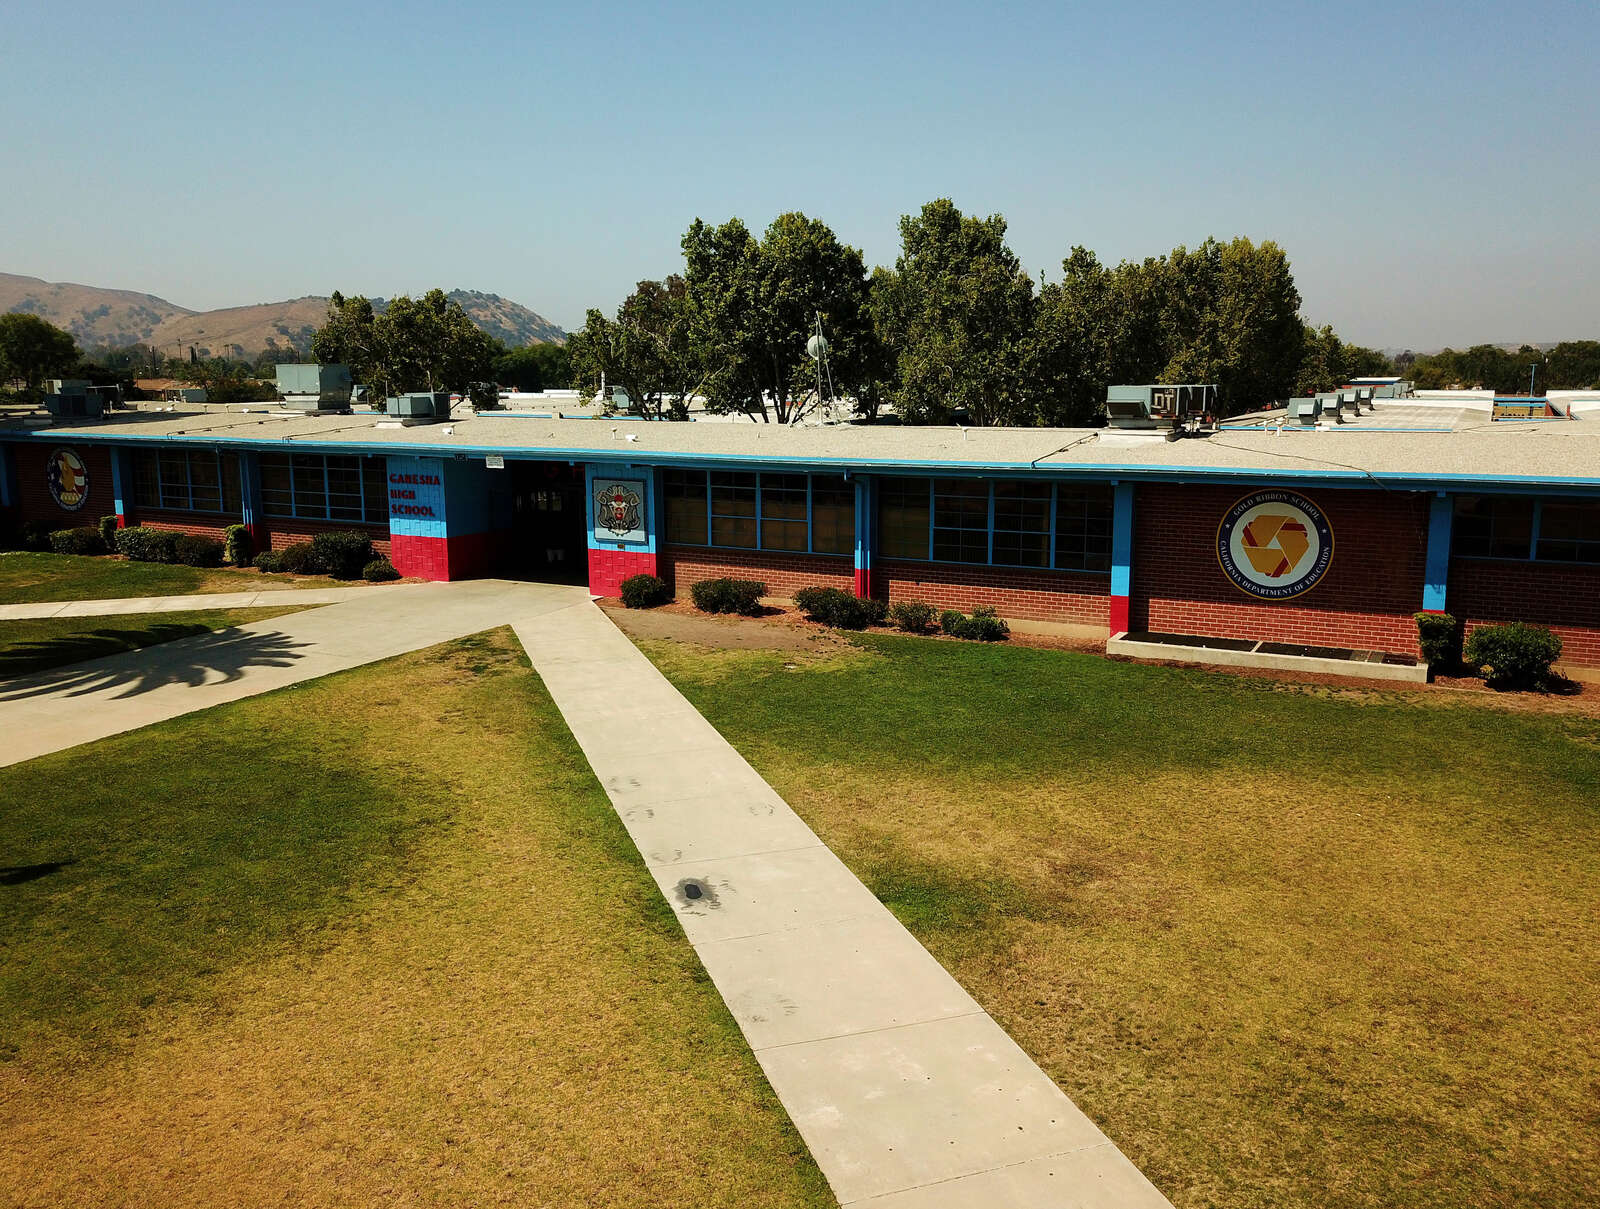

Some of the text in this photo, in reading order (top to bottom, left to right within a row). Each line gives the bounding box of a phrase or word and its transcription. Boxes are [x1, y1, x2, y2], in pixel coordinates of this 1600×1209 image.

[389, 473, 440, 485] GANESHA
[390, 489, 416, 499] HIGH
[391, 503, 436, 517] SCHOOL
[1233, 493, 1320, 520] GOLD RIBBON SCHOOL
[1220, 540, 1330, 596] CALIFORNIA DEPARTMENT OF EDUCATION
